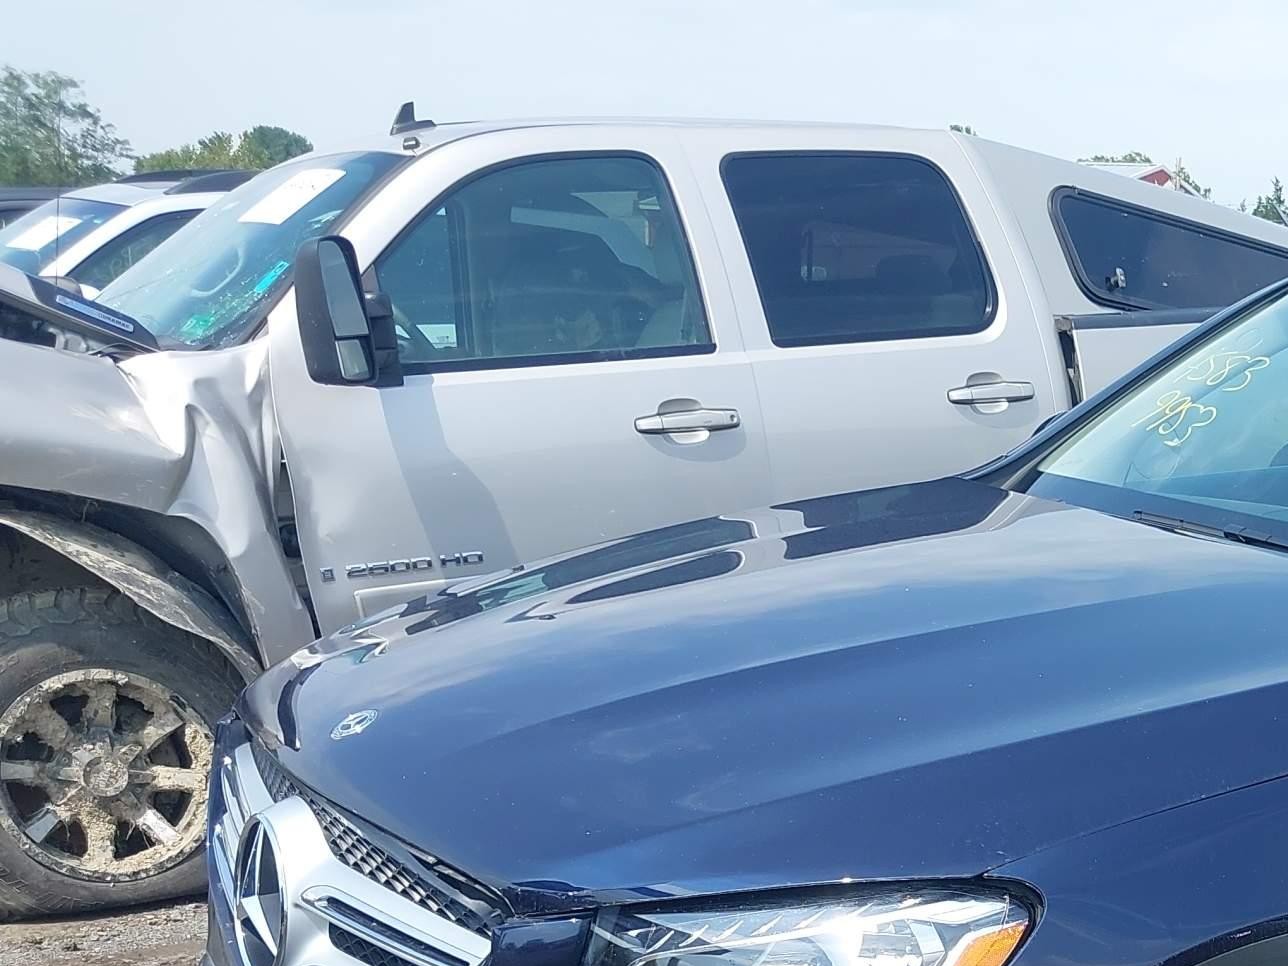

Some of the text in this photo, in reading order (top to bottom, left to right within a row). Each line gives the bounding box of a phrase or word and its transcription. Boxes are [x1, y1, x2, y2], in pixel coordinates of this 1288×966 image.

[1131, 390, 1217, 446] 9953
[345, 557, 433, 577] 2500
[440, 550, 484, 568] HD
